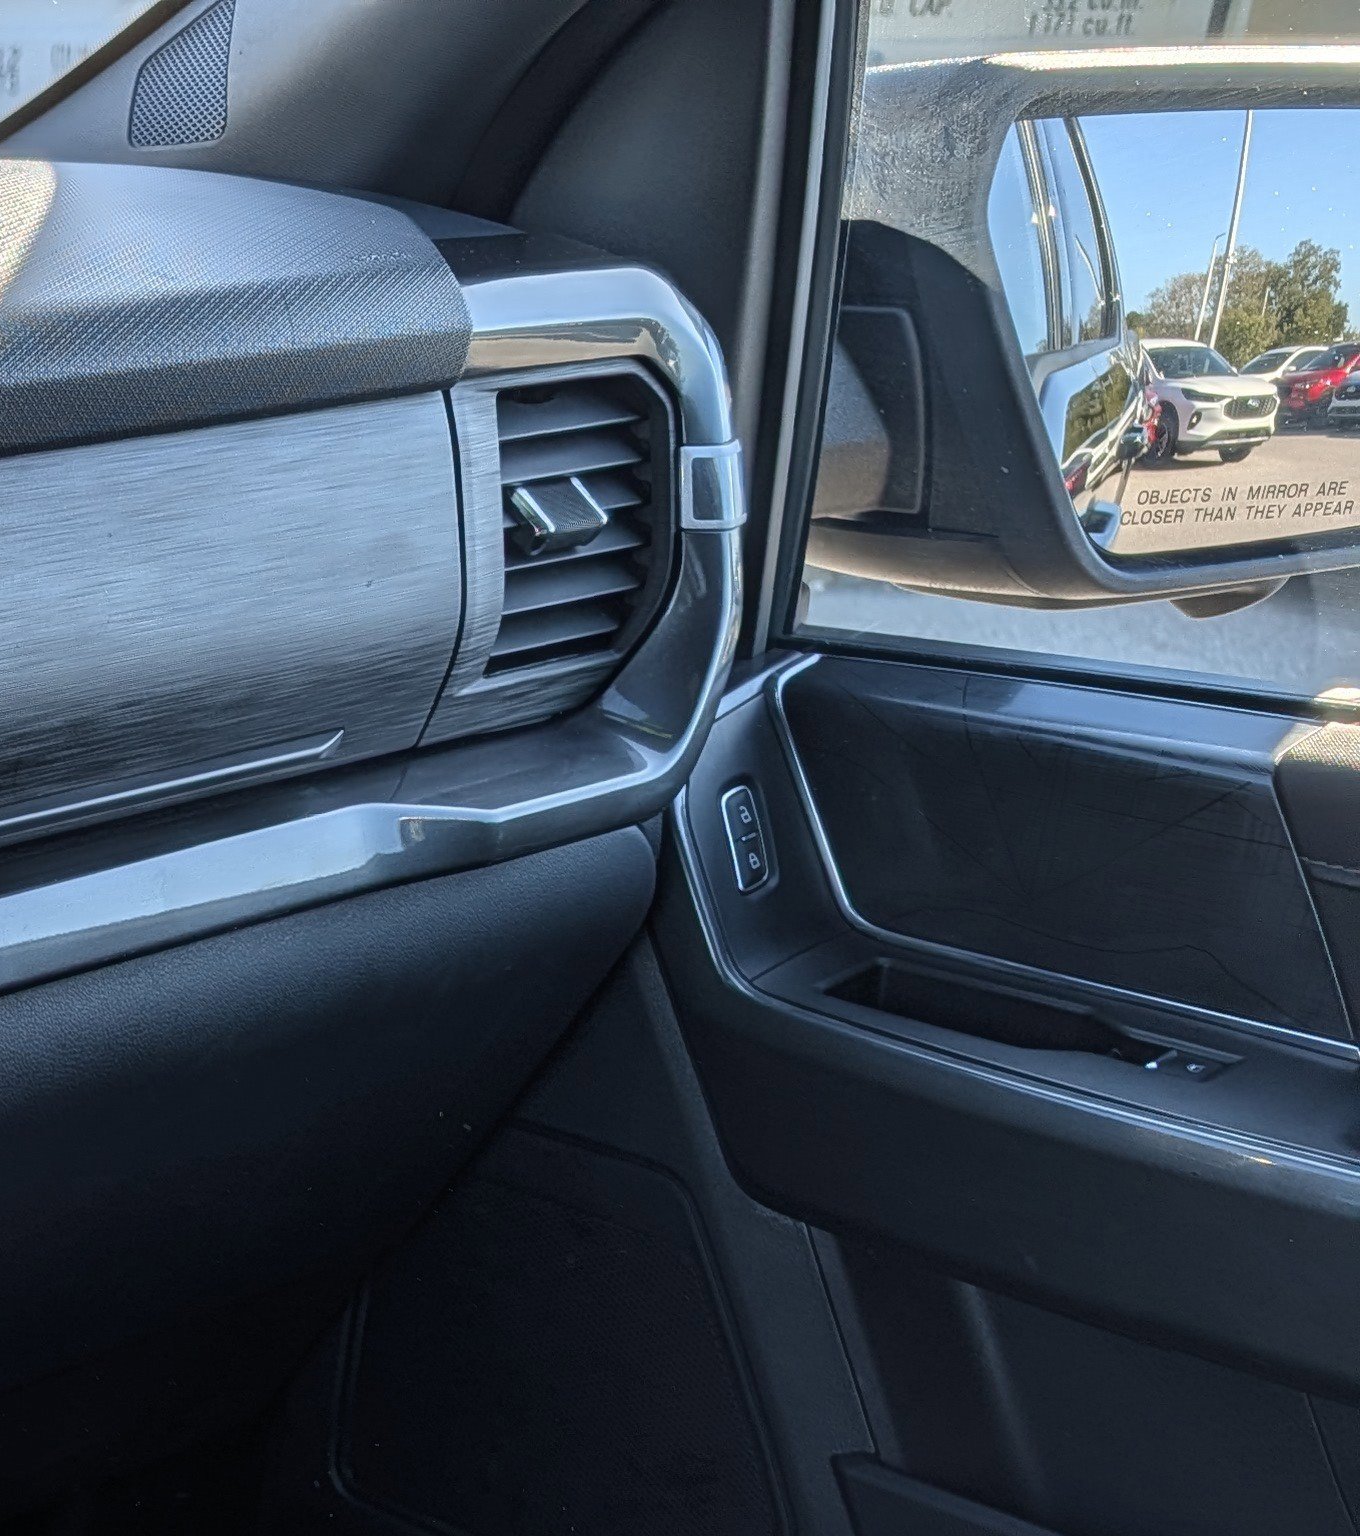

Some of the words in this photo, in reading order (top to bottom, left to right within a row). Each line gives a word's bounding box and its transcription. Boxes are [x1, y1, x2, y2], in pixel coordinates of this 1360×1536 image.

[1137, 487, 1213, 506] OBJECTS
[1220, 486, 1239, 502] IN
[1246, 483, 1310, 501] MIRROR
[1315, 480, 1349, 497] ARE
[1121, 508, 1185, 527] CLOSER
[1194, 506, 1237, 523] THAN
[1246, 503, 1287, 521] THEY
[1291, 500, 1355, 518] APPEAR
